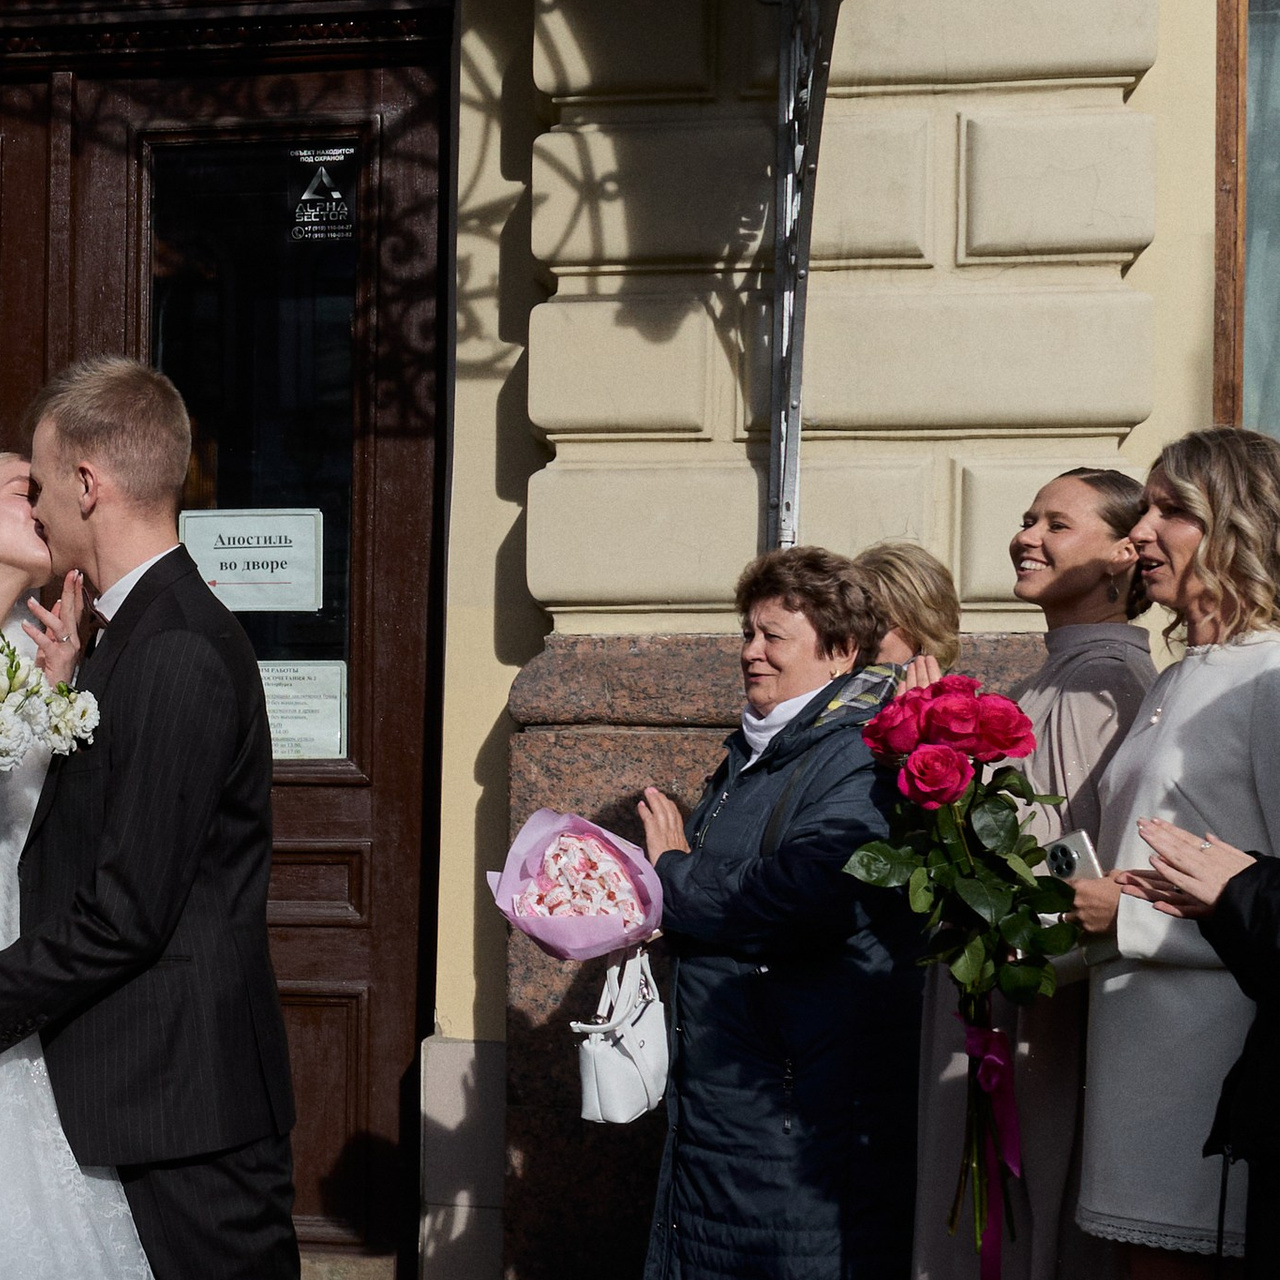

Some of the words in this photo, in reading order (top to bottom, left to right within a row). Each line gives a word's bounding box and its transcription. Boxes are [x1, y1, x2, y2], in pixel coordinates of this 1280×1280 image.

[289, 149, 315, 157] ОБЪЕКТ
[295, 202, 348, 213] ALPHA
[295, 211, 348, 222] SECTOR
[214, 533, 293, 547] Апостиль
[219, 561, 237, 571] во
[241, 559, 288, 573] дворе
